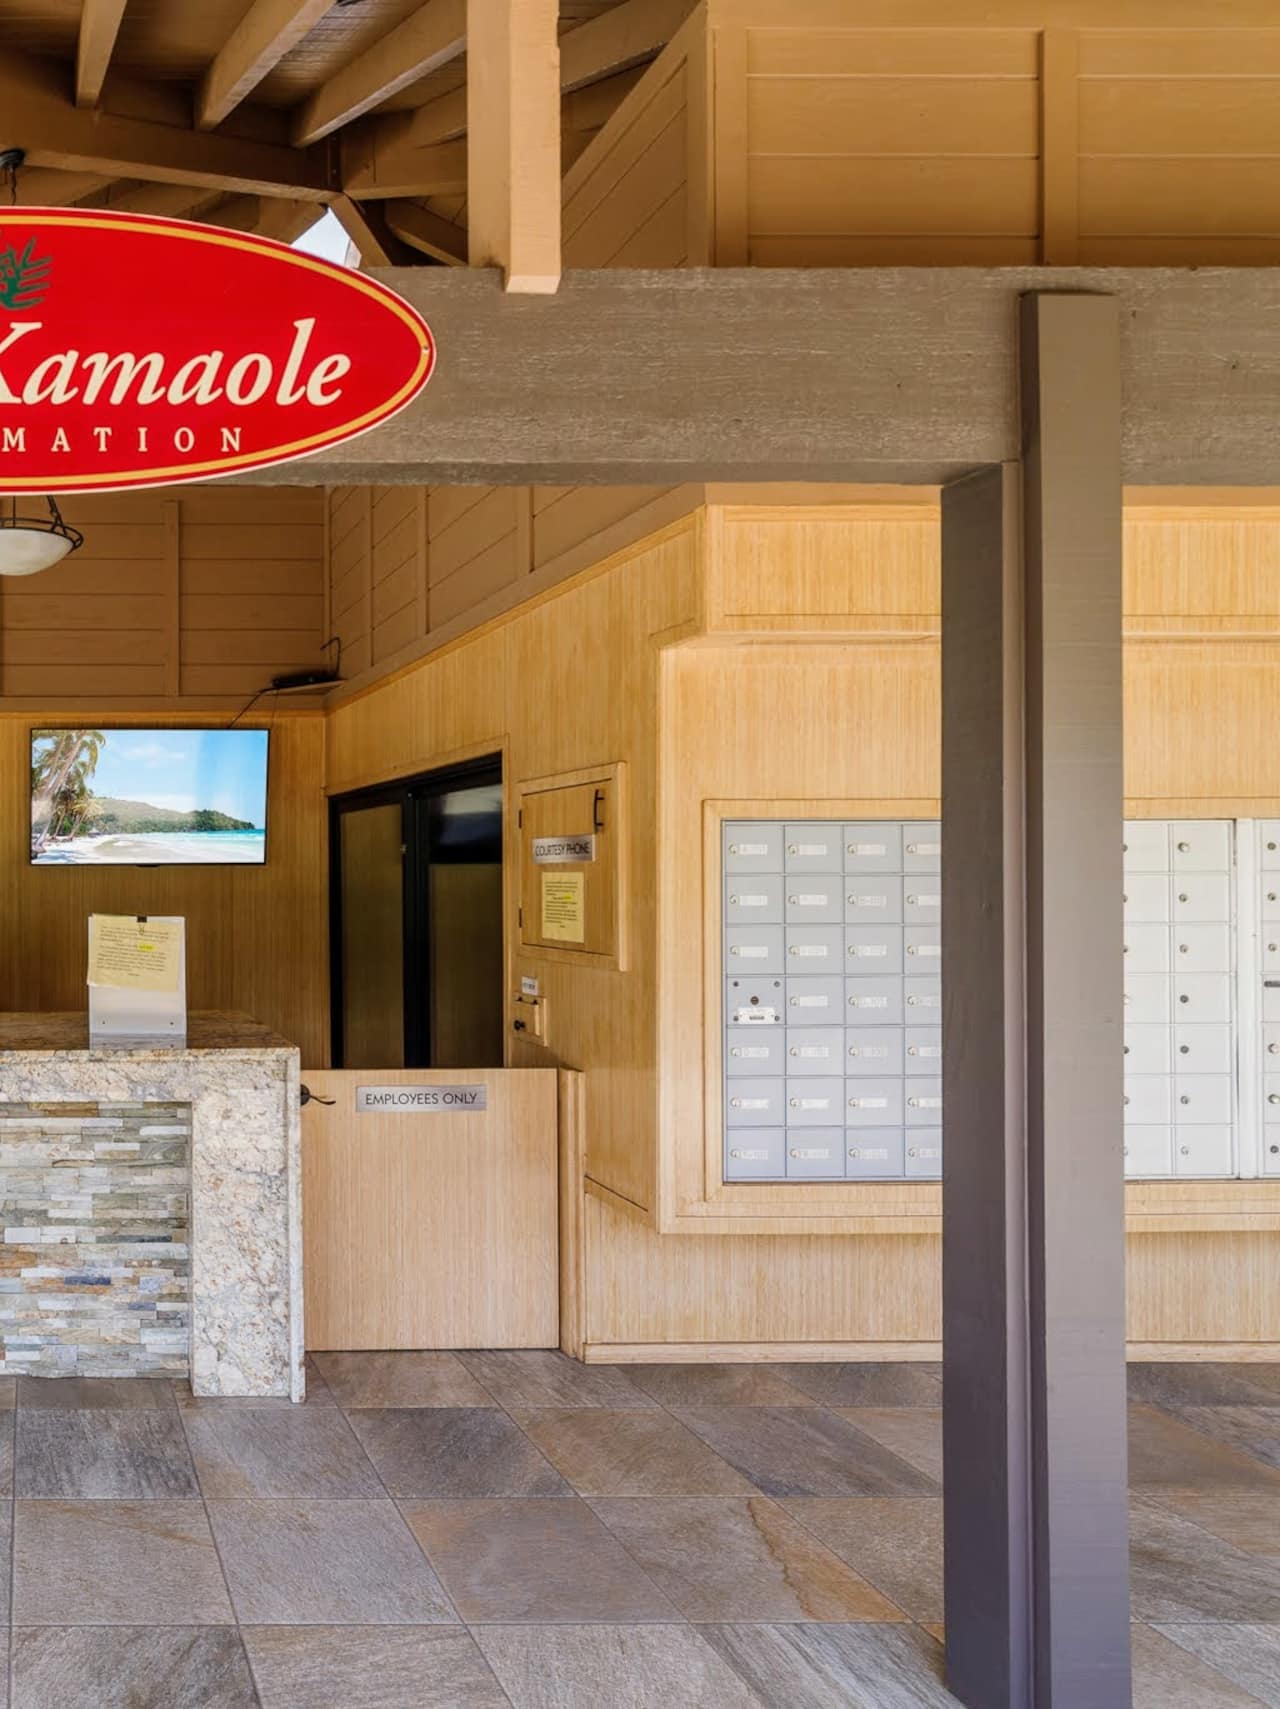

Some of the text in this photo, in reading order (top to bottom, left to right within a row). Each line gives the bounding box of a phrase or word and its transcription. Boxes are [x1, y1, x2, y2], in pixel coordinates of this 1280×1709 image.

[566, 841, 590, 855] PHONE
[365, 1092, 478, 1105] EMPLOYEES ONLY
